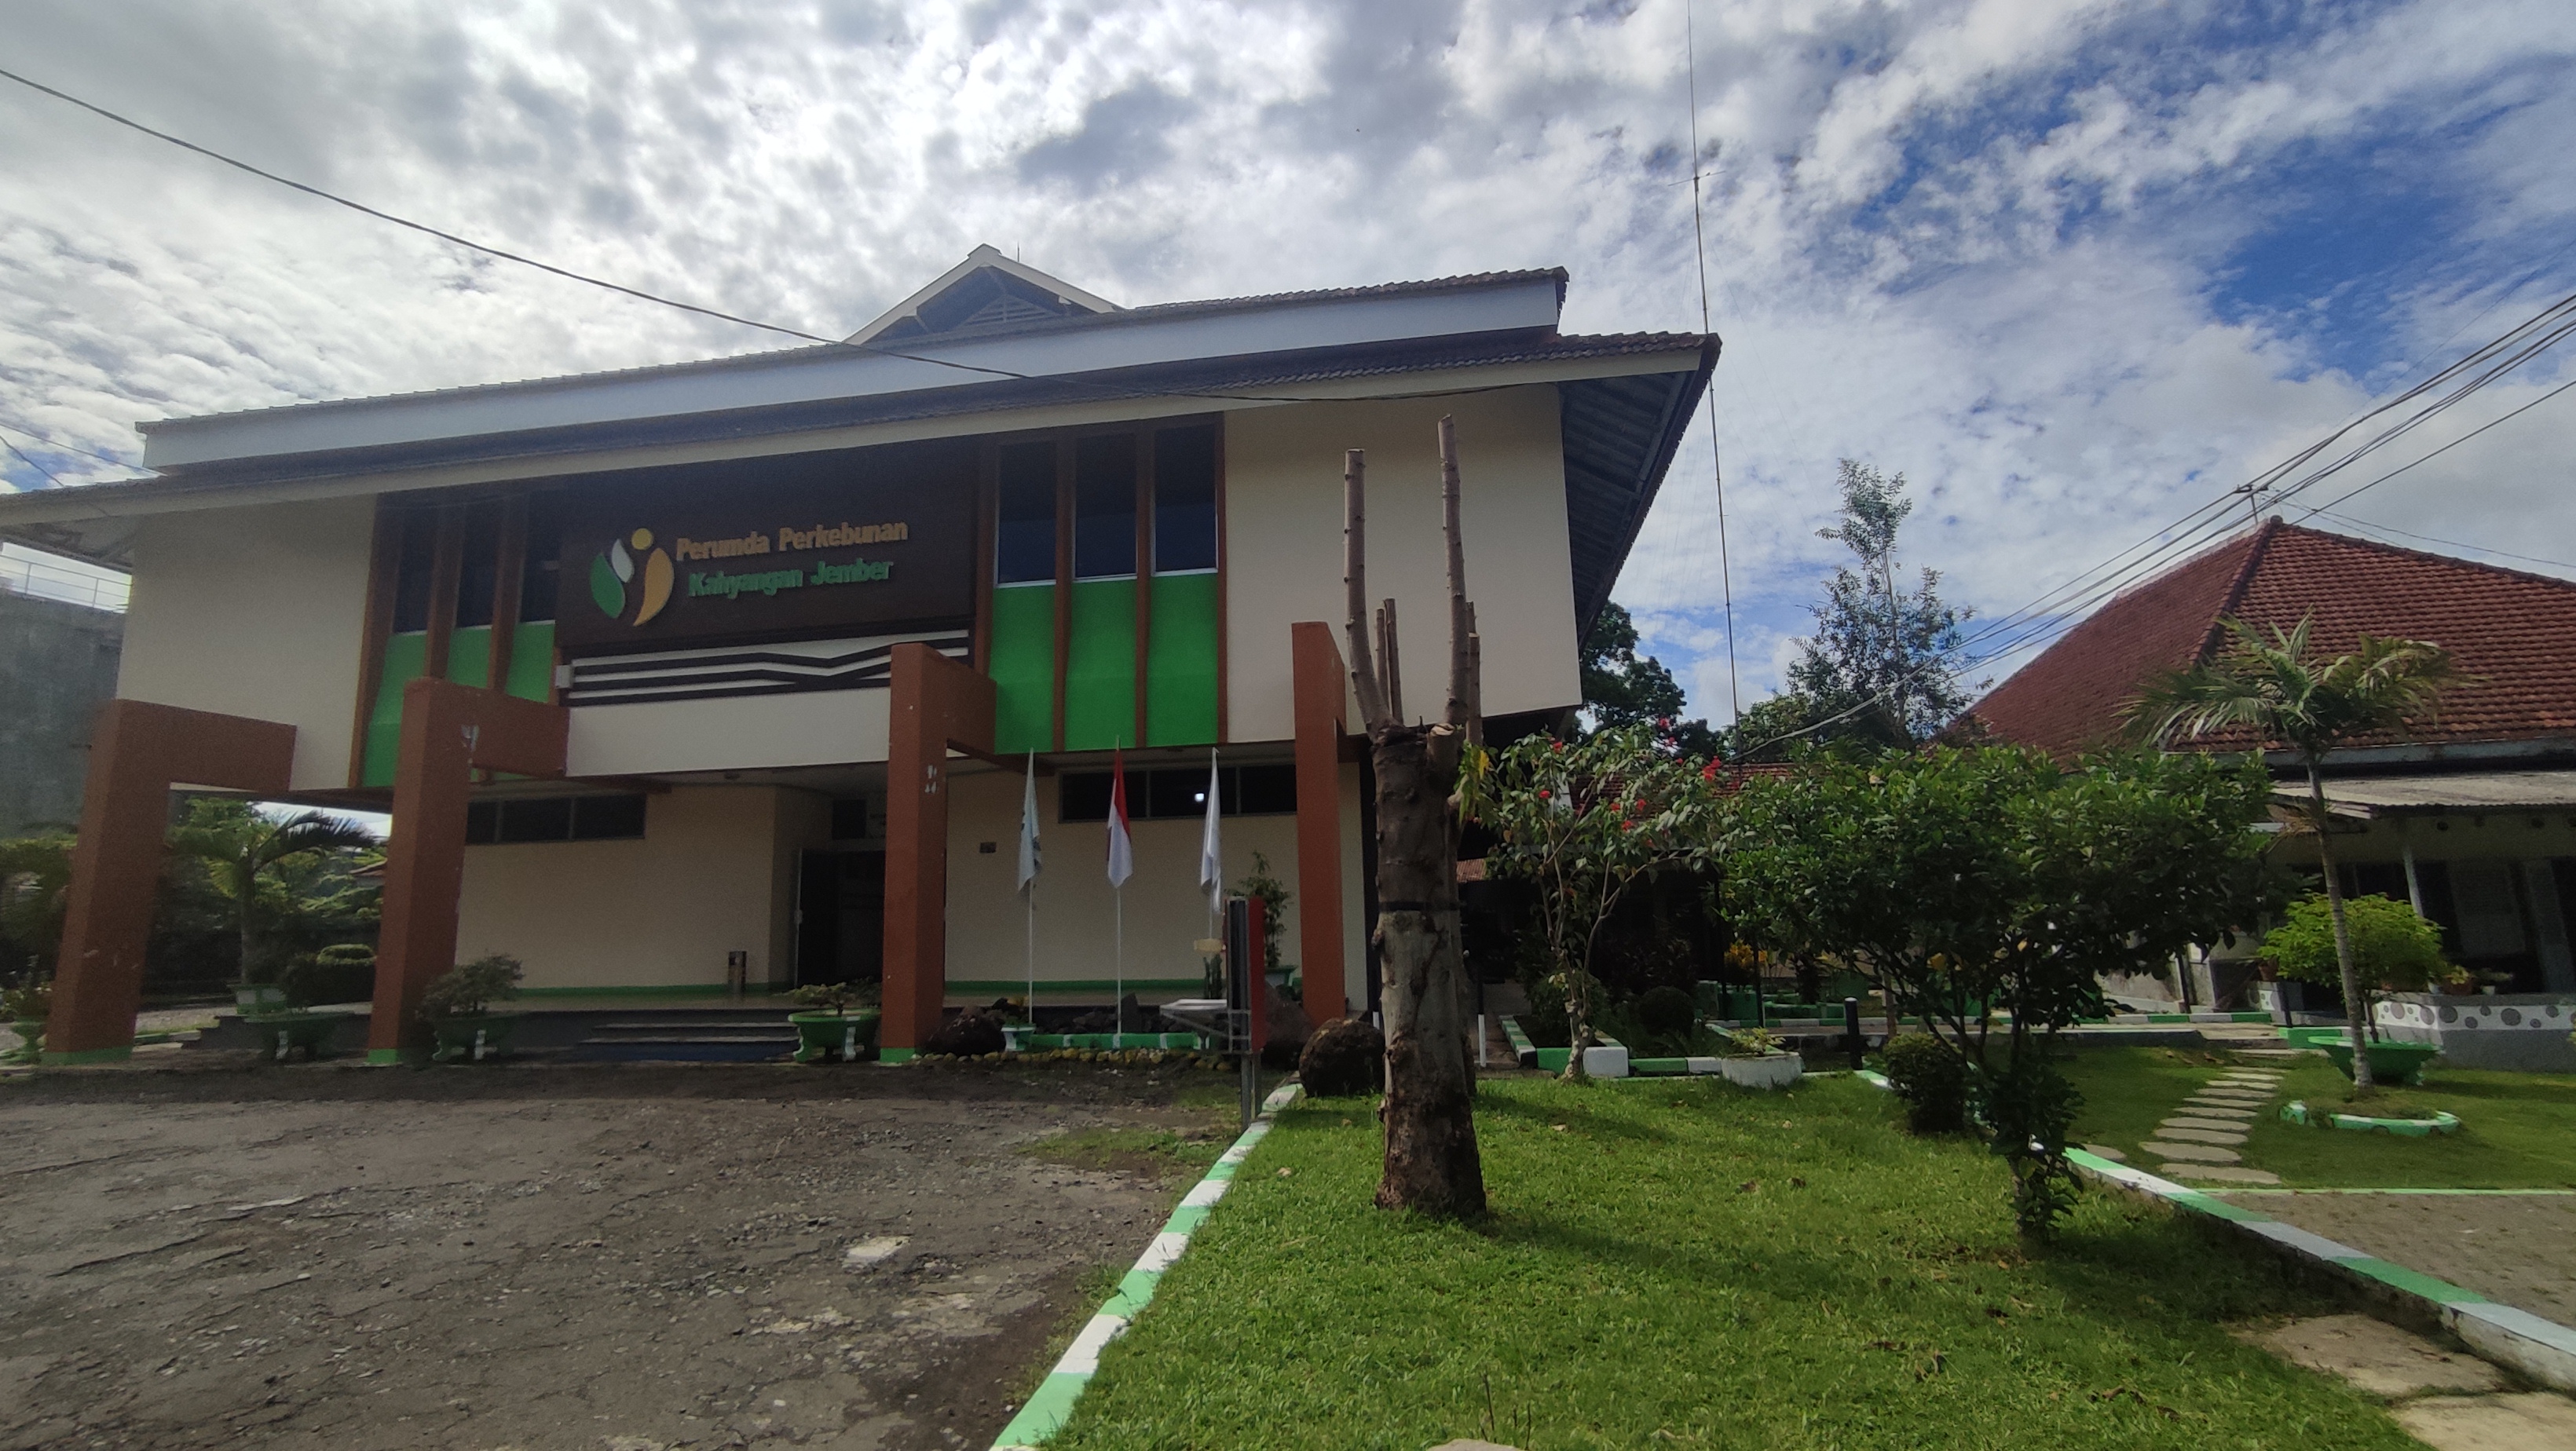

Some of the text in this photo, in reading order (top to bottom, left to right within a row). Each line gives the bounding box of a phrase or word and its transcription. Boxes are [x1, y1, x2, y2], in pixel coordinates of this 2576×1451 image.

[676, 521, 909, 561] Perumda Perkebunan
[687, 557, 895, 599] Kahyangan Jember
